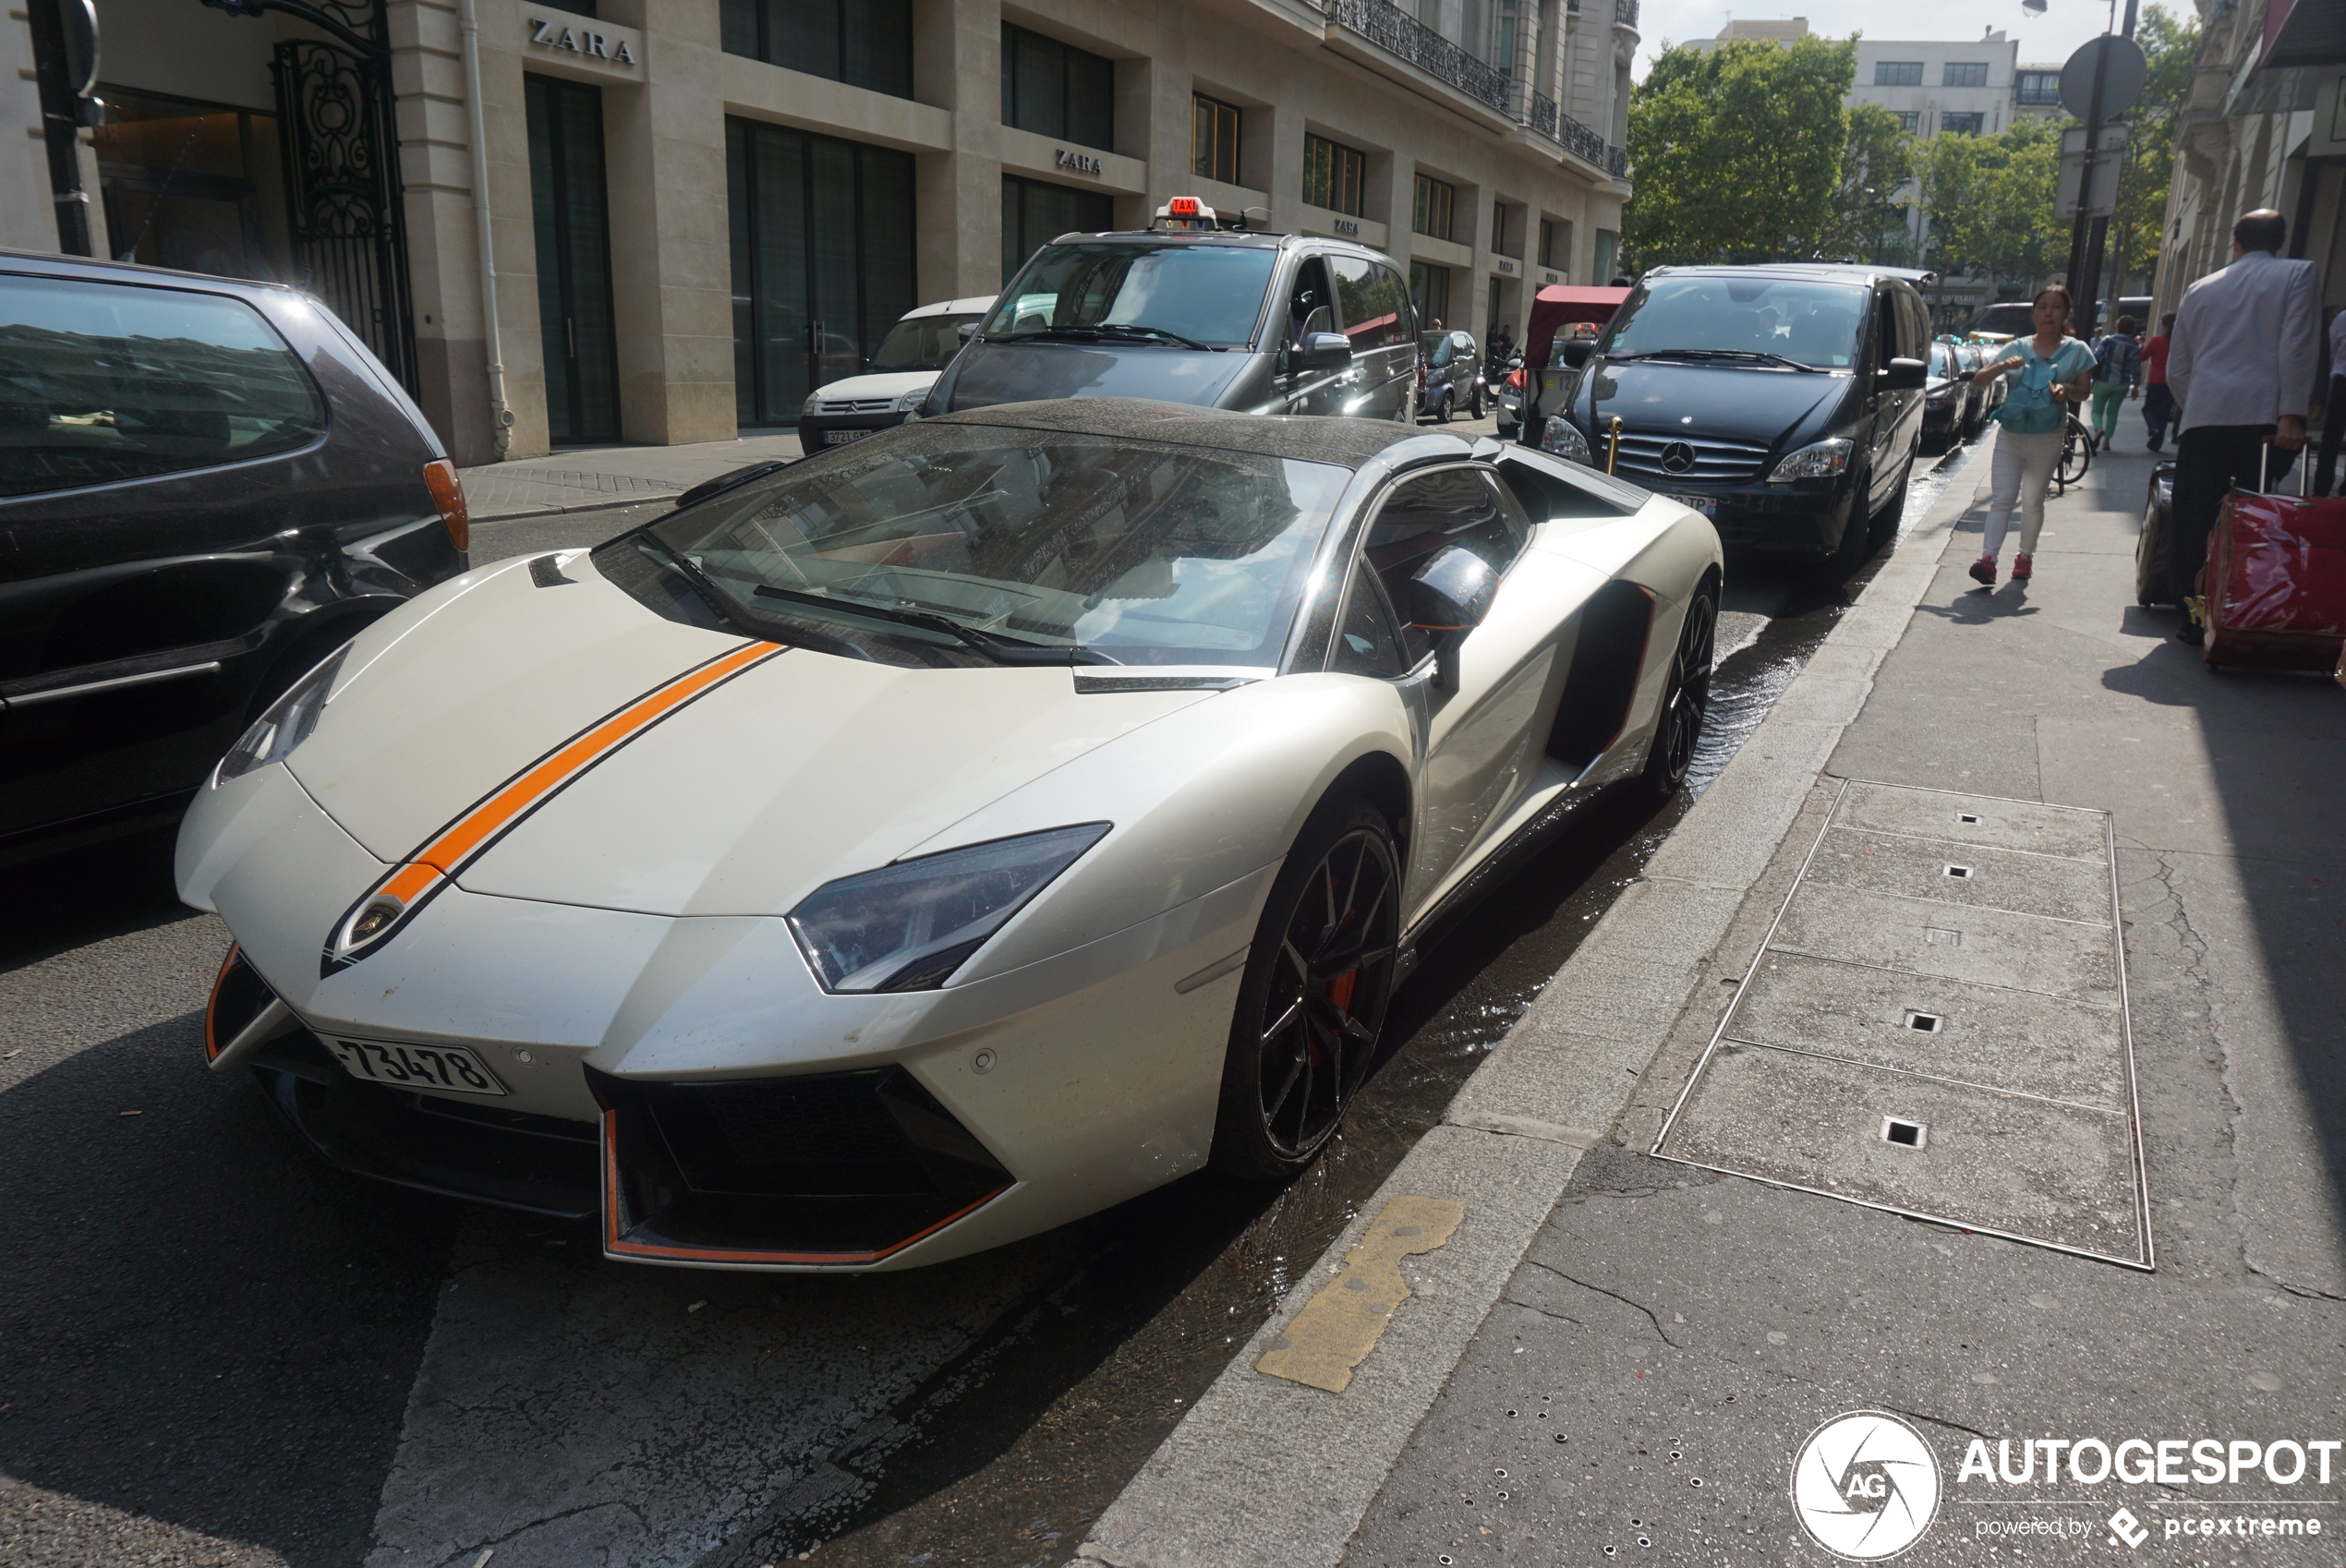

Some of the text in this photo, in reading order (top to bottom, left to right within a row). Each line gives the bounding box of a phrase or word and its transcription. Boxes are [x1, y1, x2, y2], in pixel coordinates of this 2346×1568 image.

[528, 18, 635, 65] ZARA
[1057, 149, 1103, 174] ZARA
[1173, 199, 1195, 210] TAXI
[1335, 219, 1360, 235] ZARA
[1559, 375, 1576, 391] 12
[829, 432, 852, 442] 3721
